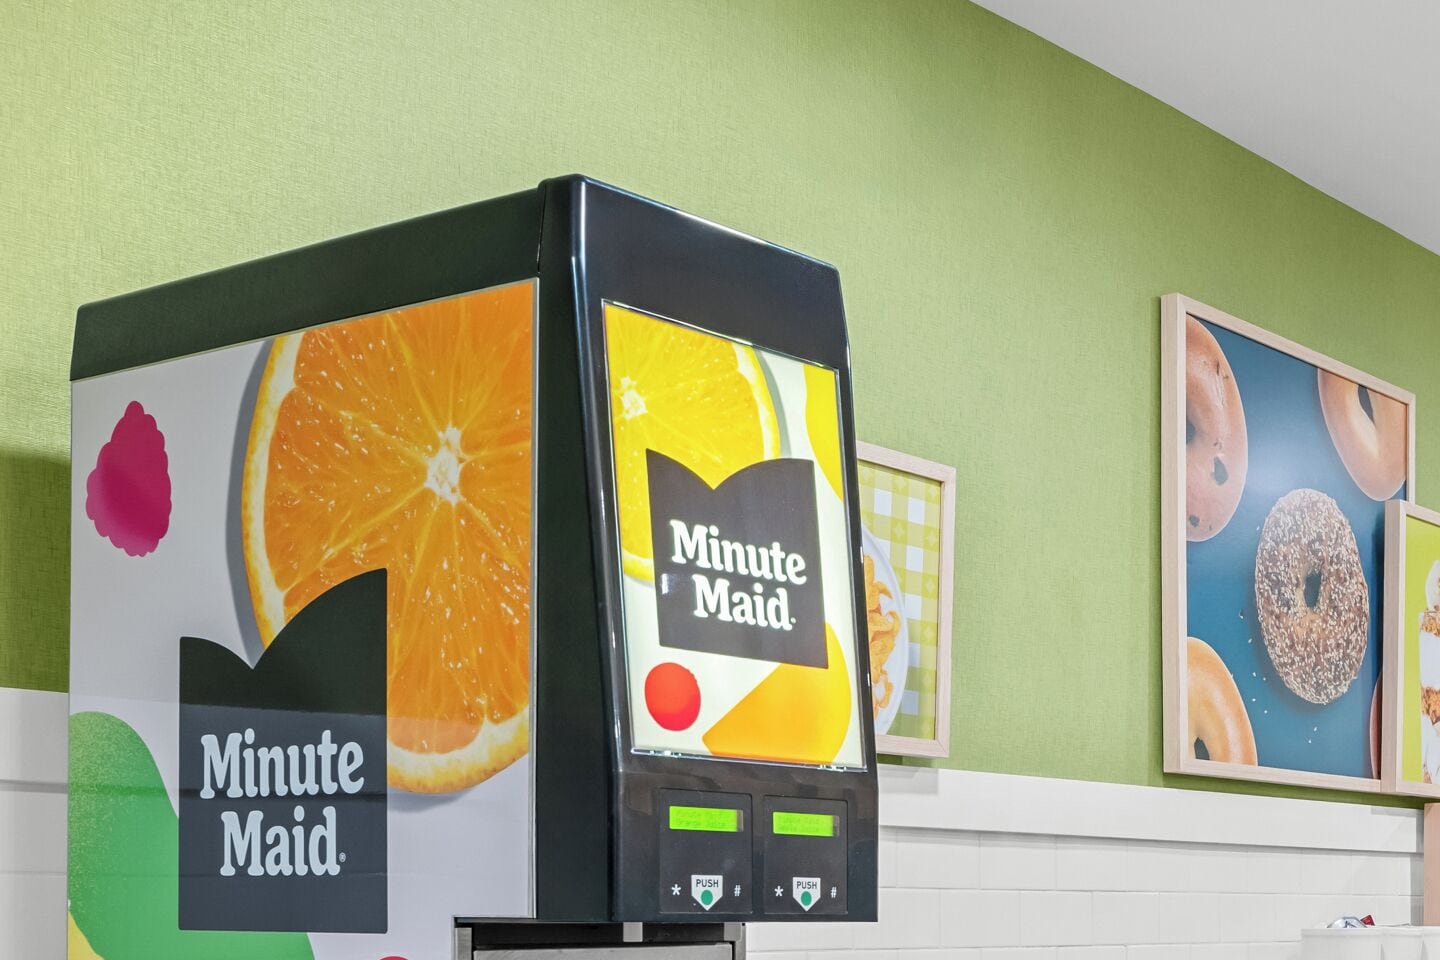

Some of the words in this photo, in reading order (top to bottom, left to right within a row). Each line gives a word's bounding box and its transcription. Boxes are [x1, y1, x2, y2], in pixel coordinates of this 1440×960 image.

[670, 519, 808, 585] Minute
[692, 573, 796, 631] Maid
[200, 728, 364, 799] Minute
[220, 805, 342, 876] Maid
[695, 878, 719, 888] PUSH
[796, 880, 818, 890] PUSH
